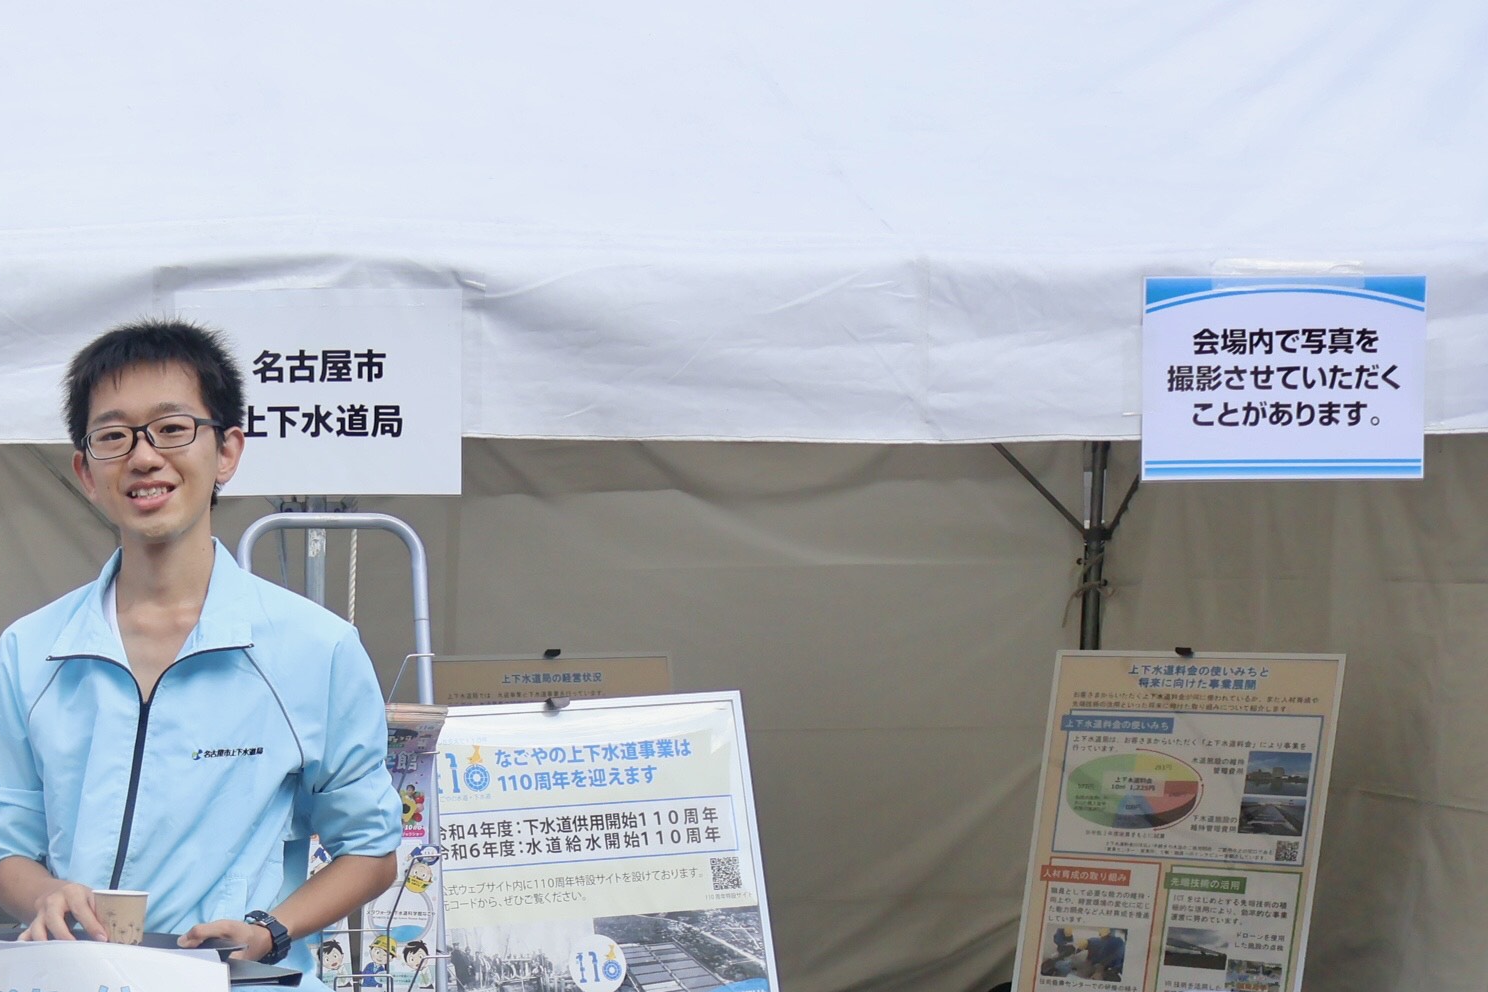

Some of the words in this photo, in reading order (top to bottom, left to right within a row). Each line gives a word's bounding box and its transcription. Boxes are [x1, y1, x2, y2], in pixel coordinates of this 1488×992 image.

[1192, 328, 1379, 355] 会場内で写真を
[252, 349, 386, 383] 名古屋市
[1167, 365, 1401, 392] 撮影させていただく
[244, 404, 403, 438] 上下水道局
[1192, 402, 1380, 427] ことがあります。
[502, 672, 602, 684] 上下水道局の経営状況
[495, 739, 692, 767] なごやの上下水道事業は
[498, 766, 658, 792] 110周年を迎えます
